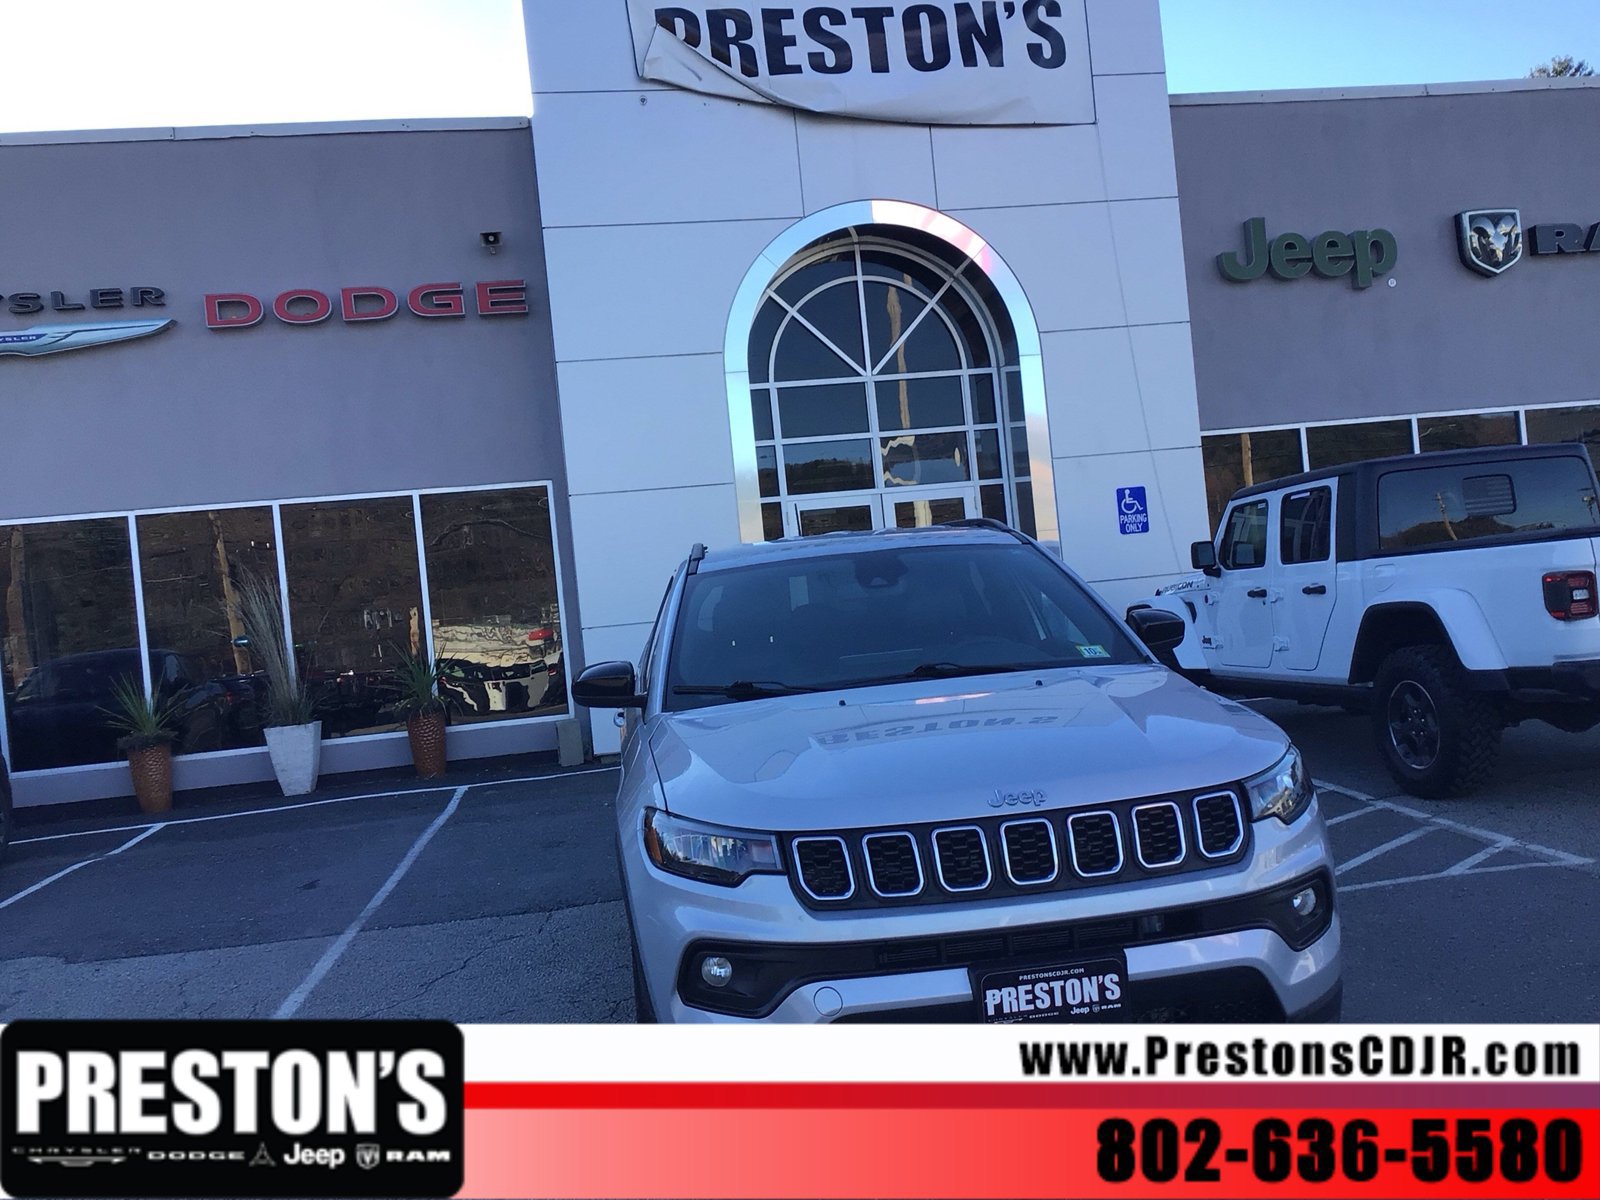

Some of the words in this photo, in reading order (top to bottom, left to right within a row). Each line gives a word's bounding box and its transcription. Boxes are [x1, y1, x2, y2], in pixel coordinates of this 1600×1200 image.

[1216, 216, 1398, 290] Jeep
[0, 286, 166, 314] SLER
[205, 279, 529, 328] DODGE
[1120, 513, 1147, 524] PARKING
[1125, 523, 1143, 533] ONLY
[988, 789, 1047, 808] Jeep
[1019, 968, 1084, 981] PRESTONSCDJR.COM
[985, 973, 1121, 1015] PRESTON'S
[1070, 1006, 1090, 1015] Jeep
